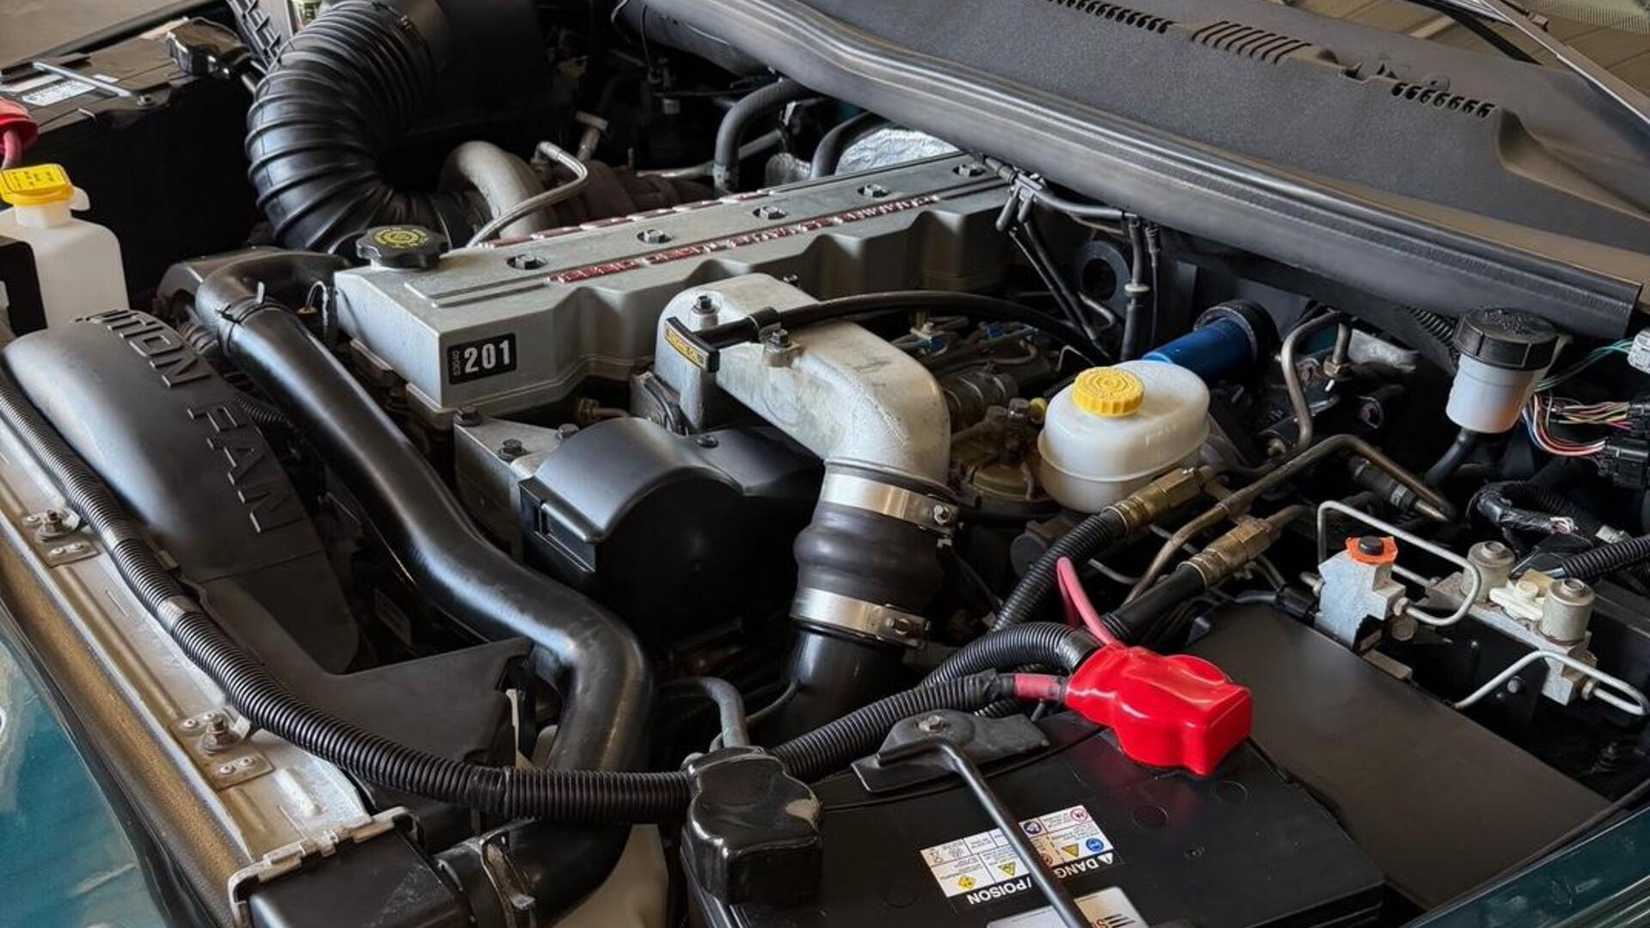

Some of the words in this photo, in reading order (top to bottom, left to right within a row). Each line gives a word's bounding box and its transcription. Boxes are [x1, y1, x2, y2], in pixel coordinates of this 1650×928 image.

[464, 340, 510, 374] 201
[185, 402, 304, 533] FAN
[1053, 857, 1099, 879] DANG
